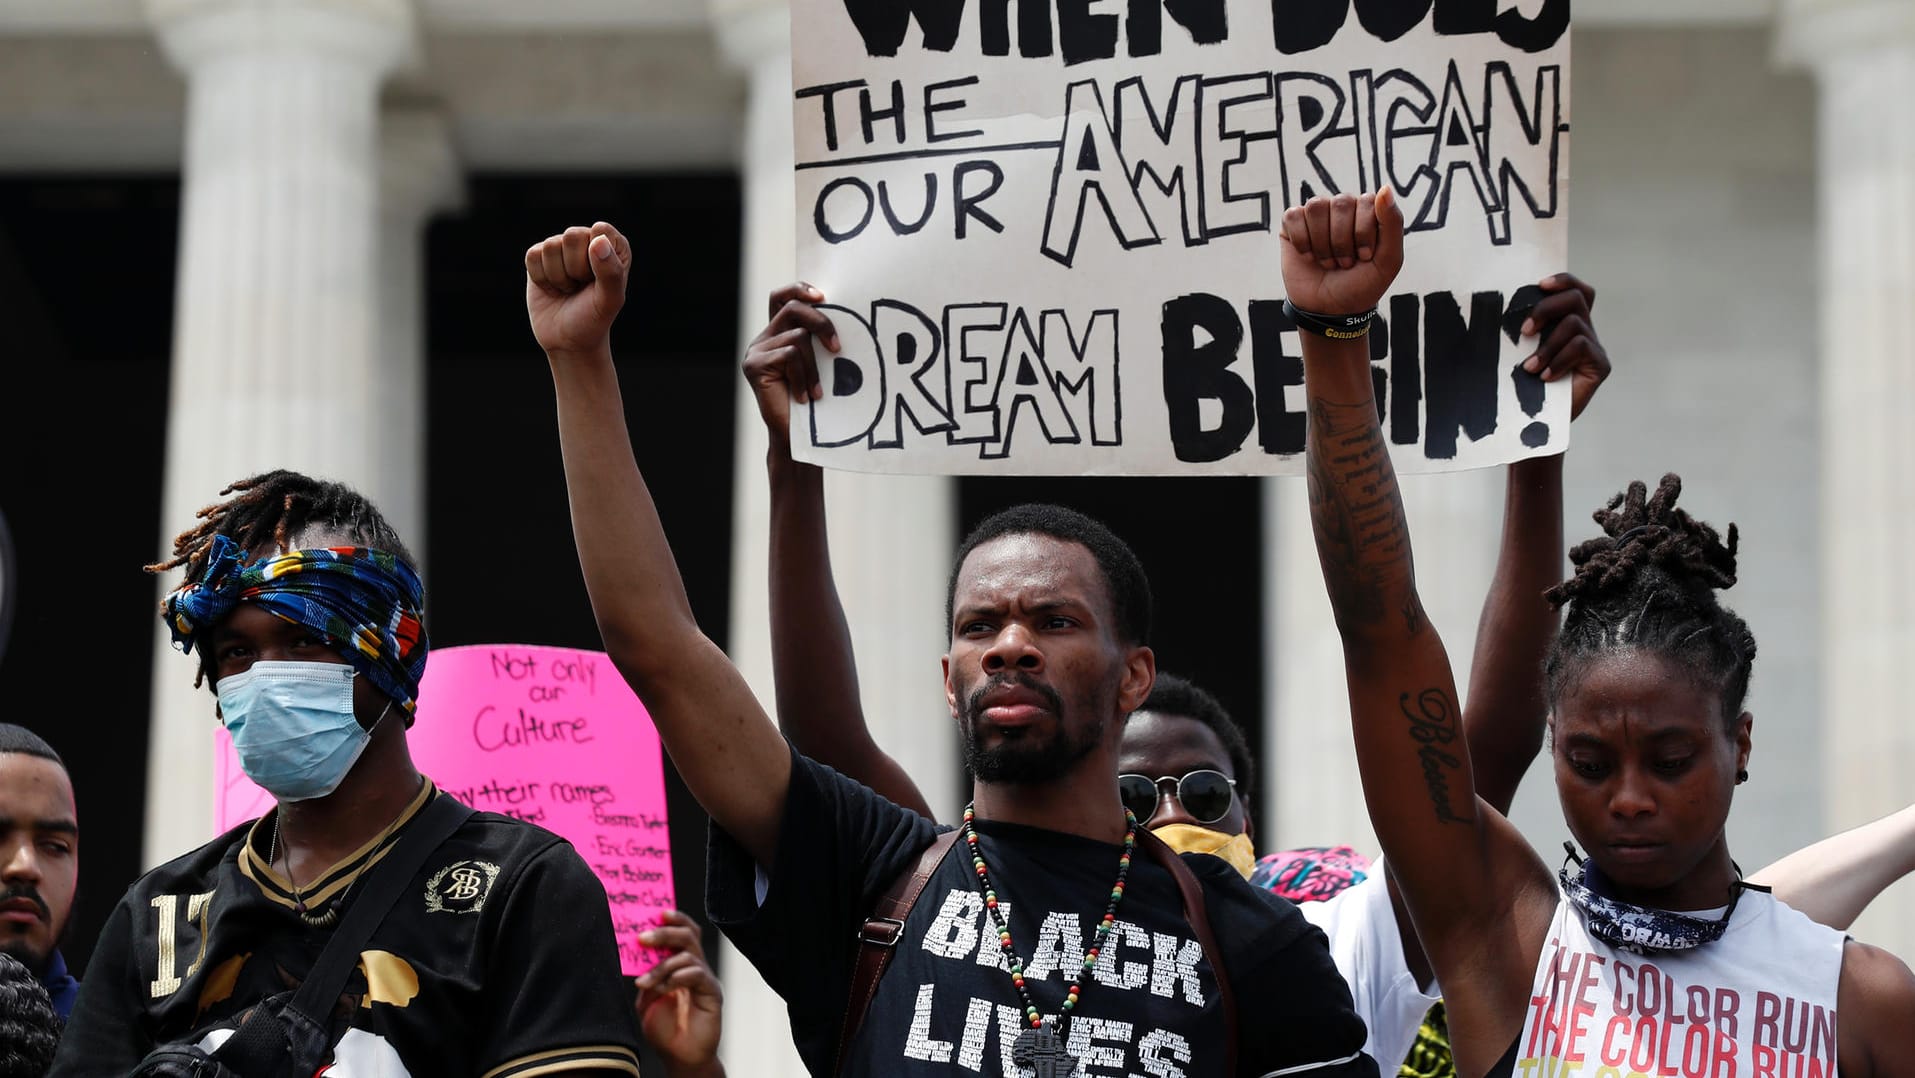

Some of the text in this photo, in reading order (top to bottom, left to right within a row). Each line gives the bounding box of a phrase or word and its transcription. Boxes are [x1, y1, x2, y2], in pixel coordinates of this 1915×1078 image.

[795, 60, 1561, 268] THE AMERICAN
[814, 160, 1005, 245] OUR
[810, 299, 1122, 459] DREAM
[490, 652, 597, 696] Not only
[473, 706, 595, 752] Culture
[479, 779, 542, 804] their
[1047, 917, 1079, 927] MARTIN
[921, 888, 1206, 1008] BLACK
[1126, 939, 1150, 949] GRAY
[1123, 972, 1148, 984] ERIC
[967, 1008, 991, 1019] ERIC
[997, 1004, 1021, 1016] OSCAR
[1611, 961, 1741, 1040] COLOR
[1753, 991, 1837, 1062] RUN
[1071, 1016, 1133, 1031] TRAYVON MARTIN
[1071, 1024, 1132, 1040] ERIC GARNER
[1525, 995, 1595, 1062] THE
[1600, 1014, 1739, 1078] COLOR
[1066, 1041, 1090, 1051] DAVIS
[1138, 1046, 1159, 1061] TILL
[1098, 1052, 1125, 1061] DIALLO
[1173, 1051, 1192, 1064] GRAY
